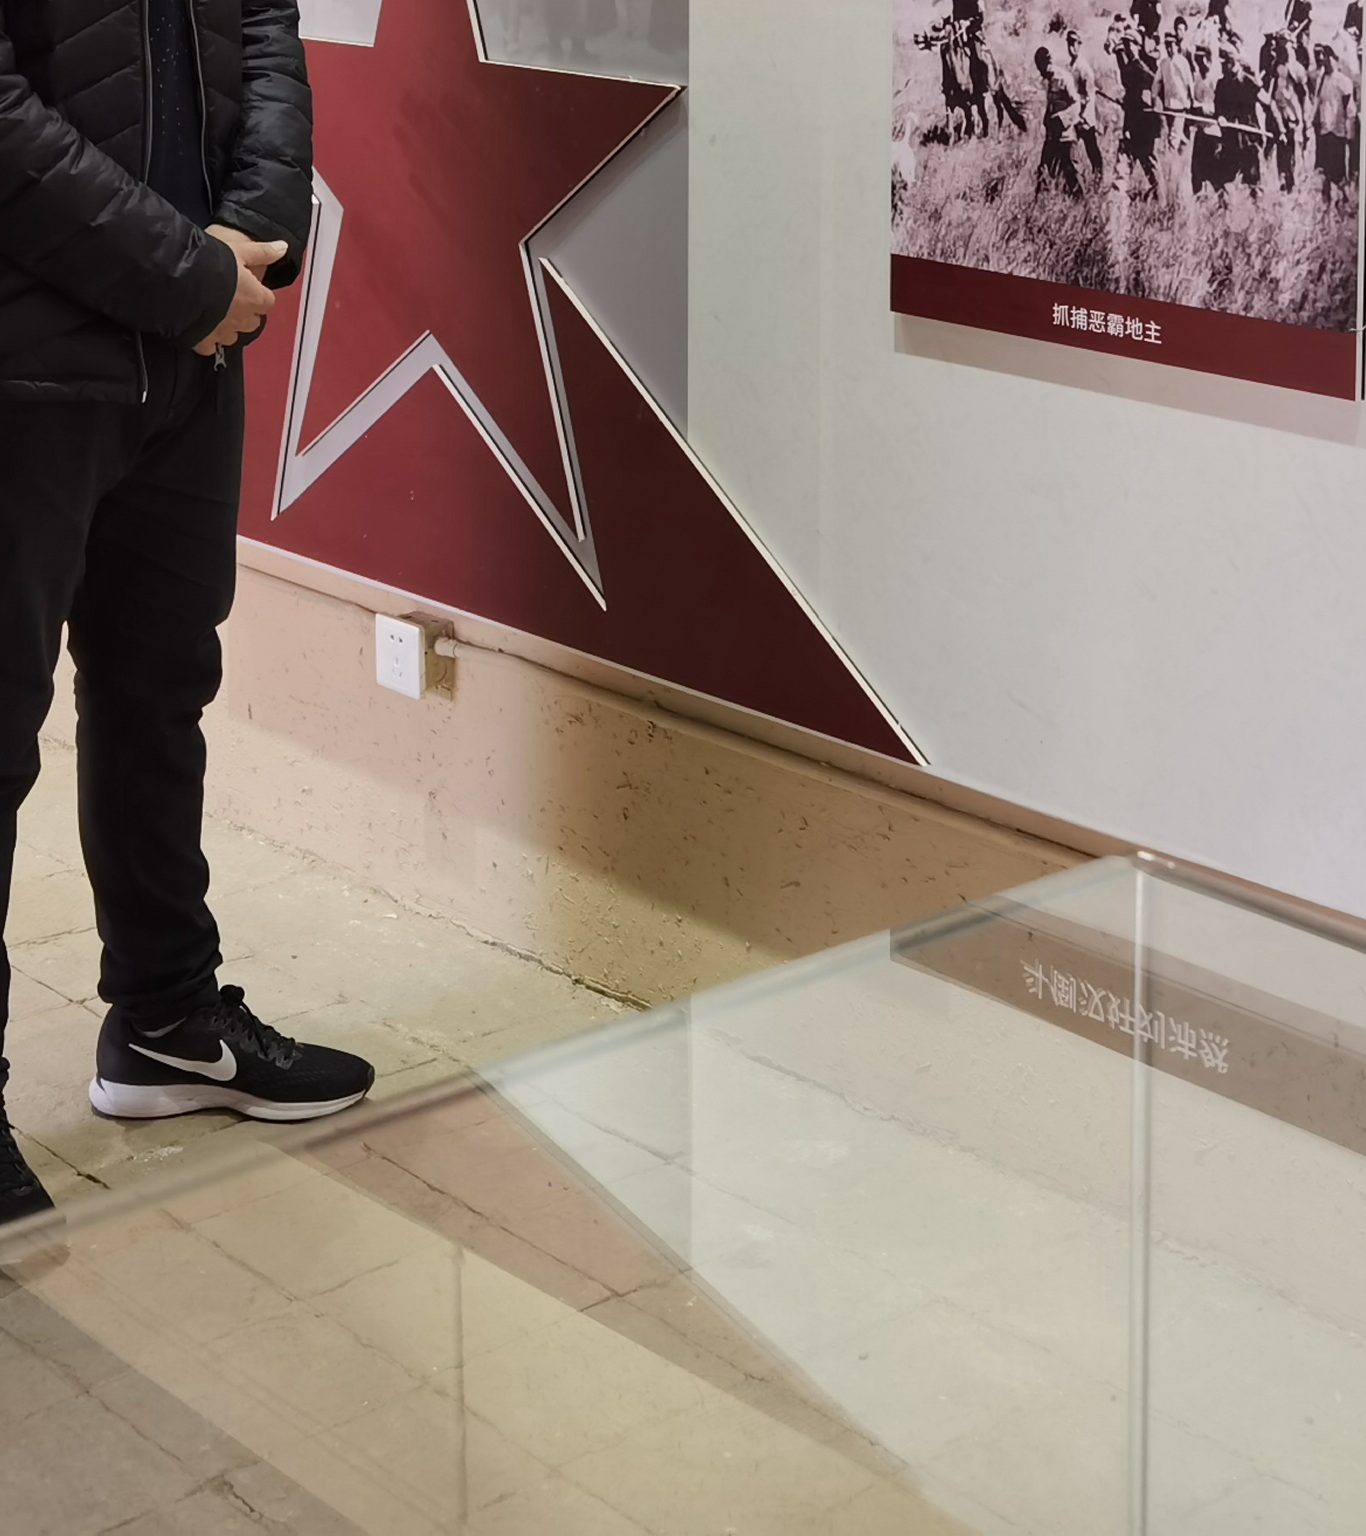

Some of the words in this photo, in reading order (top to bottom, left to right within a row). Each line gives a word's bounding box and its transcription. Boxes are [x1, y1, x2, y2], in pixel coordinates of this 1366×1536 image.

[1052, 302, 1163, 345] 抓捕恶霸地主
